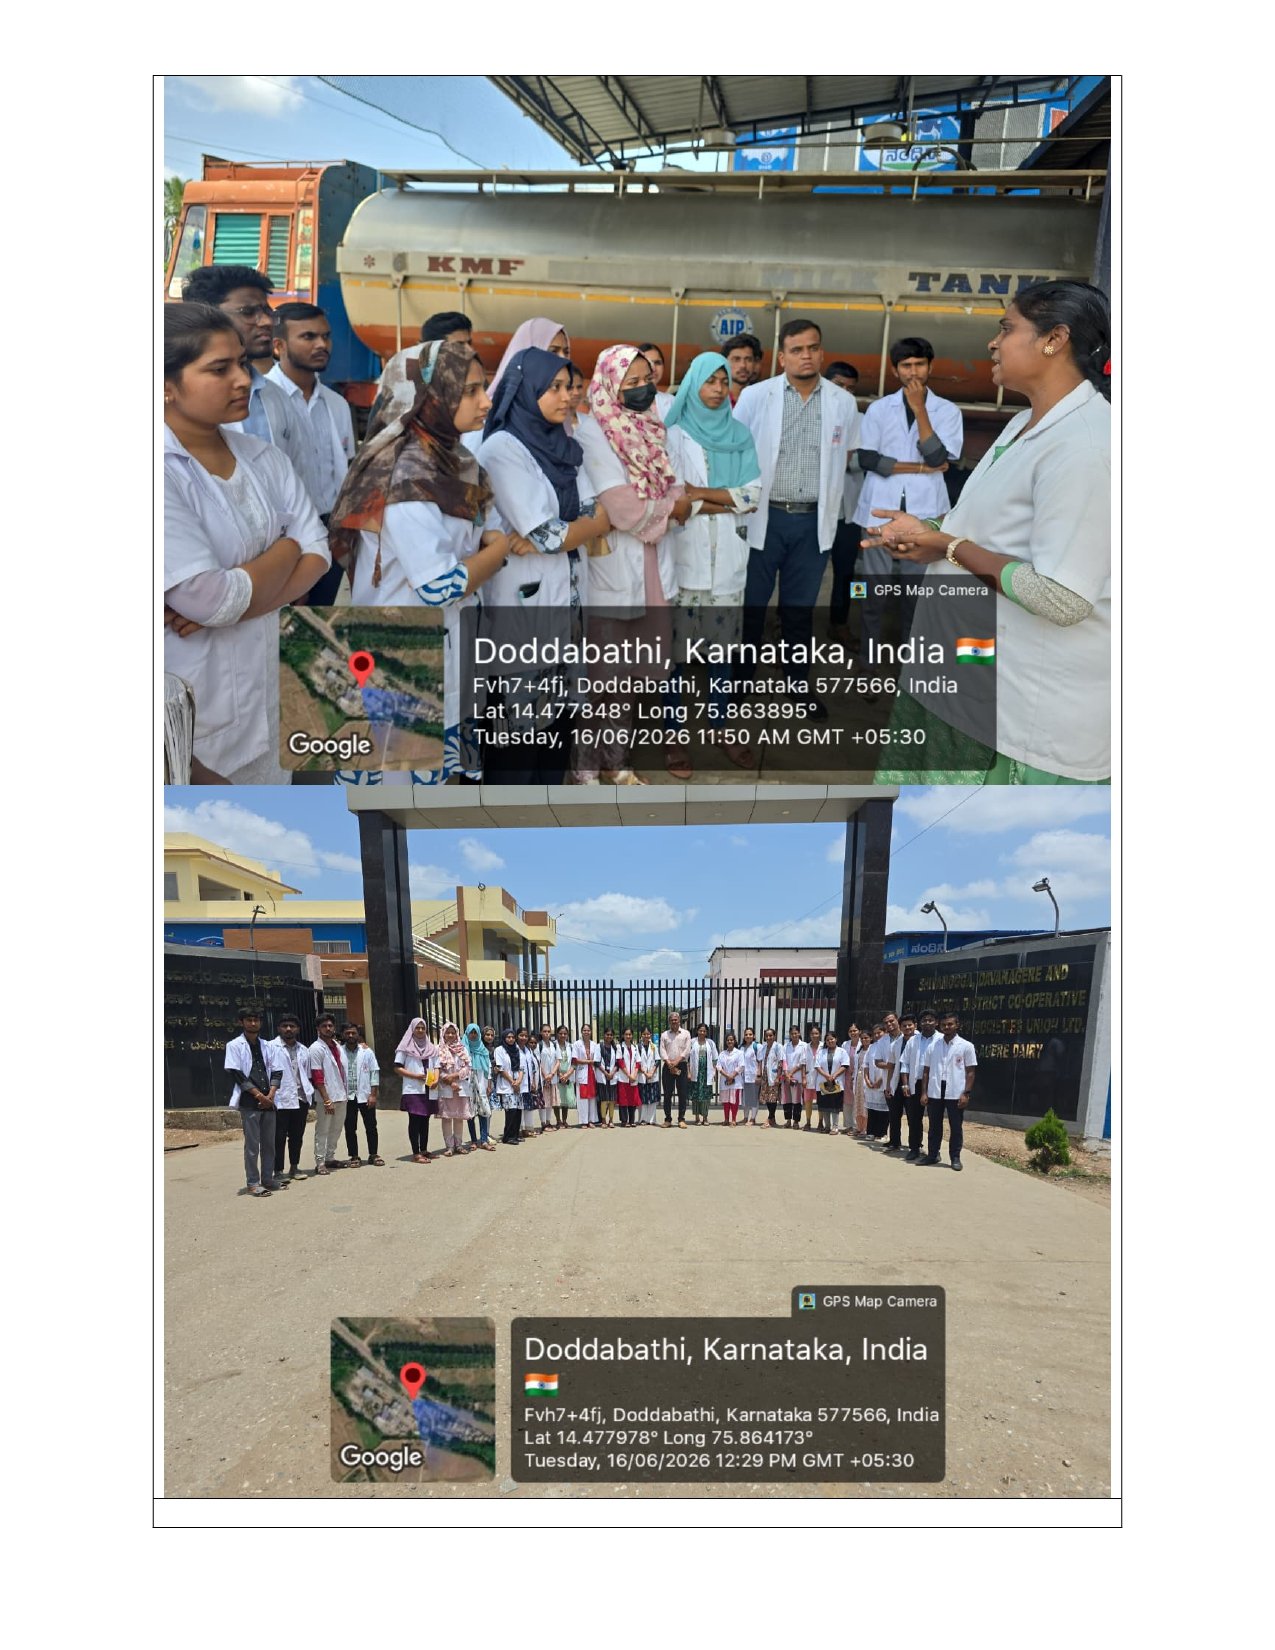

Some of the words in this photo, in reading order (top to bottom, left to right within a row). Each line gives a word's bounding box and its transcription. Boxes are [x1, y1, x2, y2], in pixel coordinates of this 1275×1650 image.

[427, 256, 525, 276] KMF
[908, 271, 1090, 294] TANK
[720, 318, 745, 336] AIP
[978, 966, 1042, 988] DAVANAGERE
[1044, 963, 1070, 982] AND
[1008, 990, 1087, 1010] CO-OPERATIVE
[977, 1043, 1010, 1059] AGERE
[1013, 1042, 1044, 1059] DAIRY
